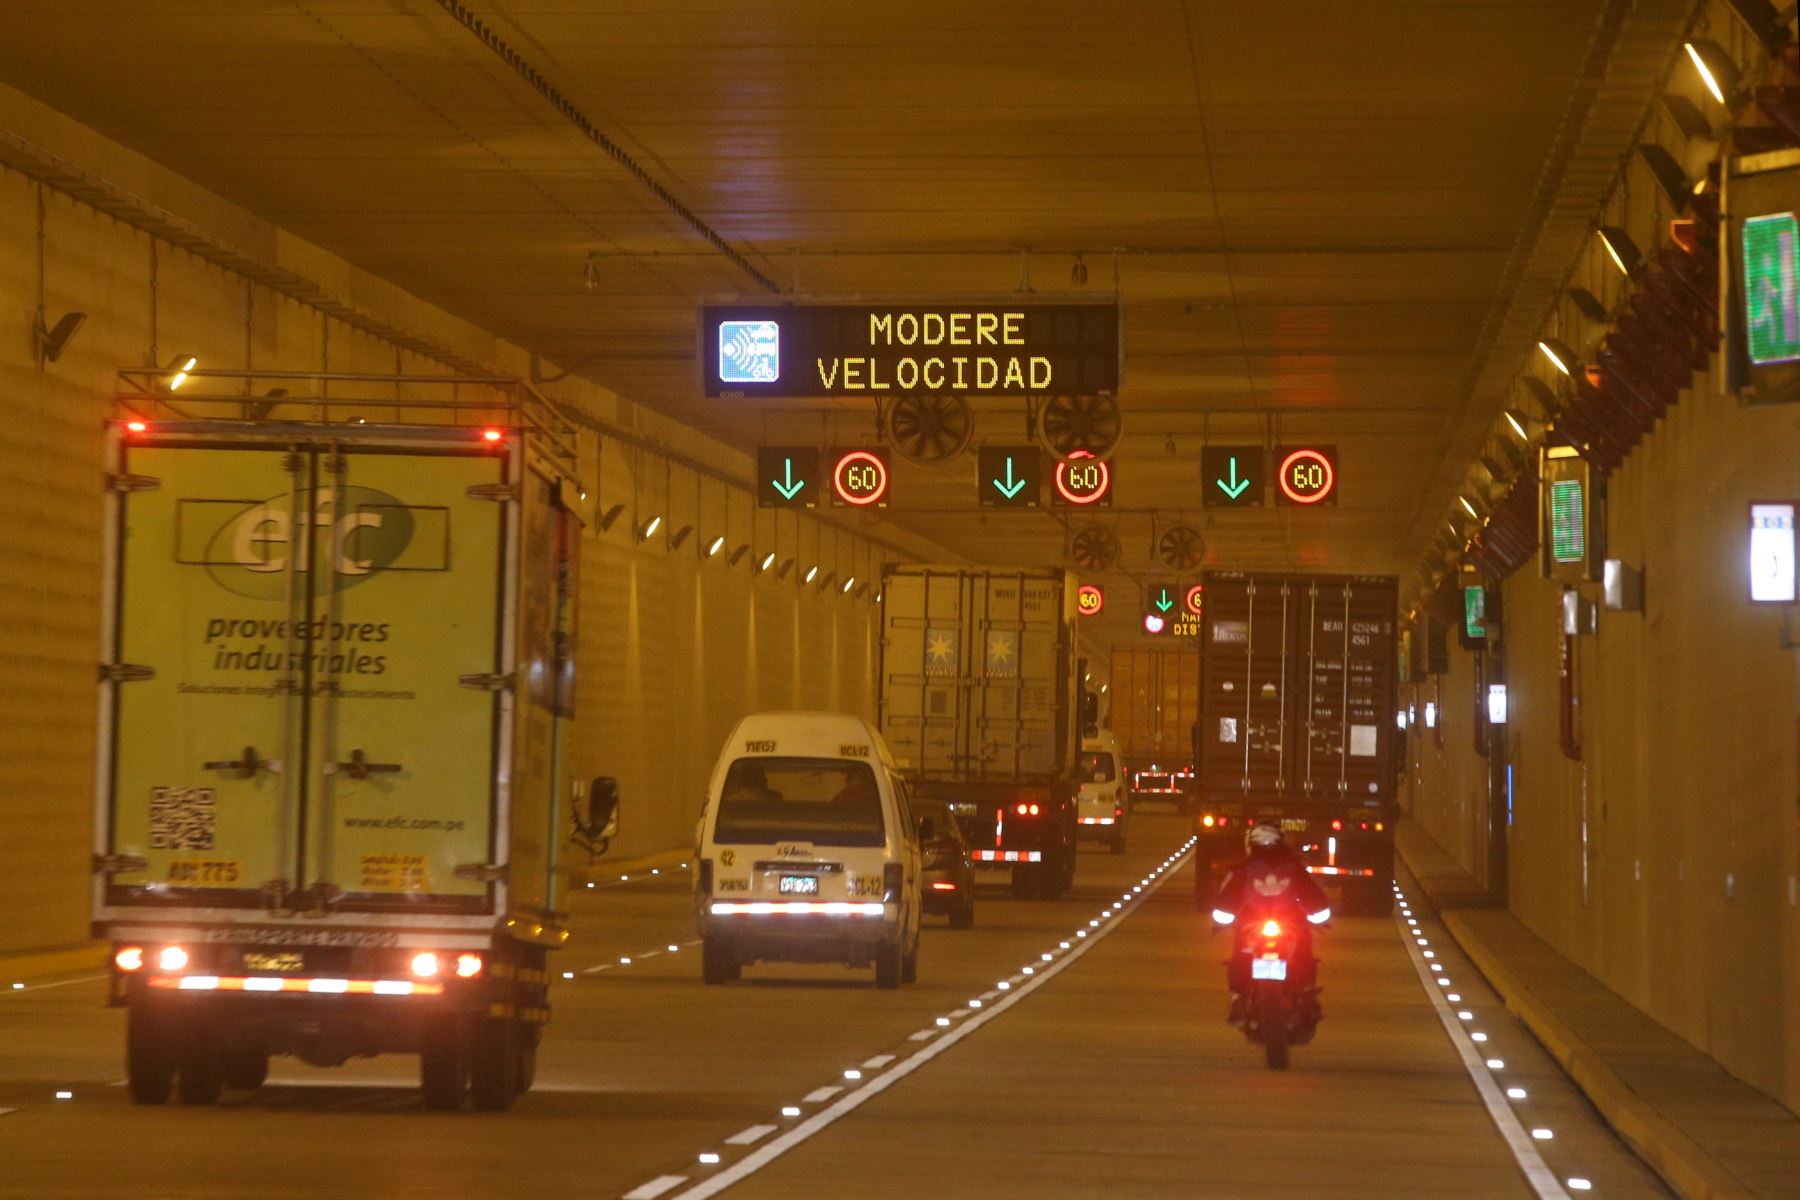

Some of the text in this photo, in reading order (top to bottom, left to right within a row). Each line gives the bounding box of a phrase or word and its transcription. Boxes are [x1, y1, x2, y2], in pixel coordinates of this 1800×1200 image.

[869, 313, 1026, 346] MODERE
[816, 356, 1053, 390] VELOCIDAD
[848, 466, 877, 491] 60
[1070, 465, 1099, 490] 60
[1293, 464, 1323, 489] 60
[232, 488, 384, 576] efc
[1079, 593, 1098, 608] 60
[204, 613, 390, 644] proveedores
[1181, 610, 1201, 623] MA
[1173, 623, 1201, 636] DIS
[213, 644, 388, 675] industriales
